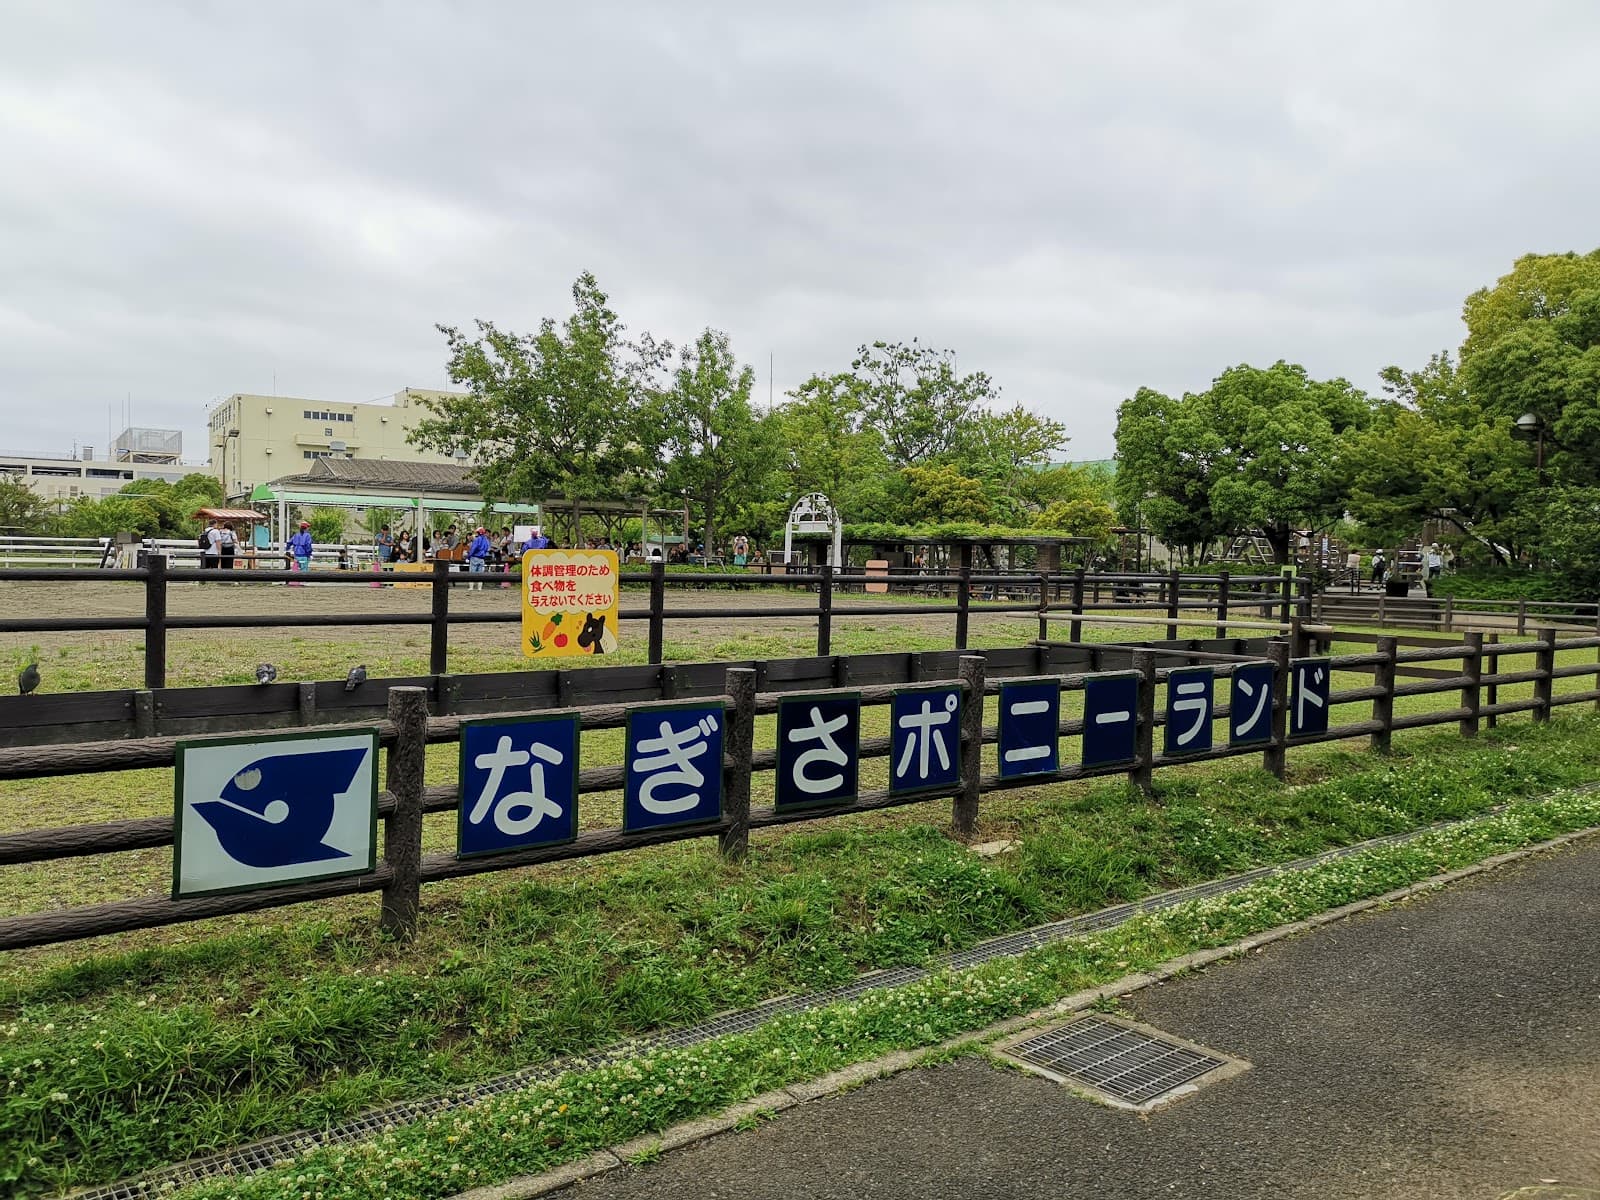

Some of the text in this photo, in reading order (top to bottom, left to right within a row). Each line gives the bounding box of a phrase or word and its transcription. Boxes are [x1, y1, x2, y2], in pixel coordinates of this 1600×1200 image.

[530, 564, 610, 577] 体調管理のため
[530, 580, 577, 592] 食べ物を
[530, 594, 612, 607] 与えないでください
